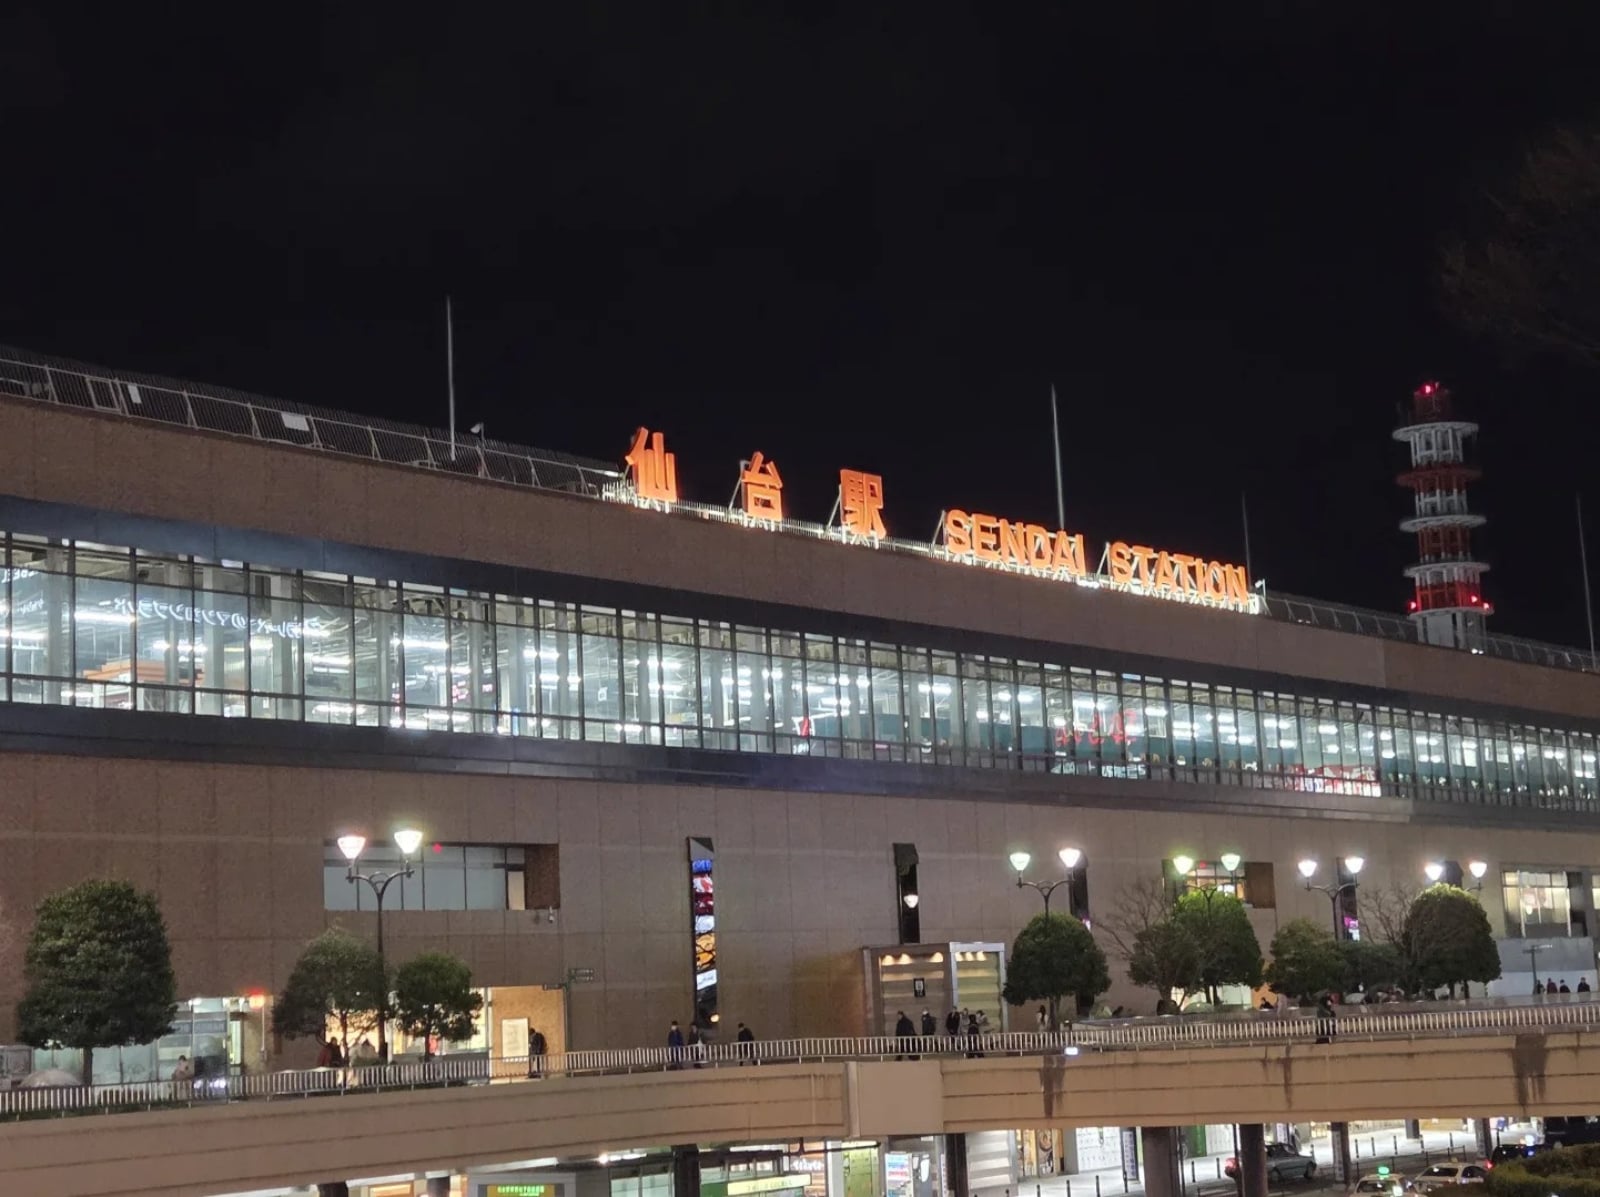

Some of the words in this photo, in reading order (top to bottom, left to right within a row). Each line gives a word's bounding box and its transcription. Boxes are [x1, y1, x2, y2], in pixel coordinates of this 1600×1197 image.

[625, 427, 887, 539] 仙台駅
[946, 509, 1086, 577] SENDAI
[1109, 541, 1248, 604] STATION
